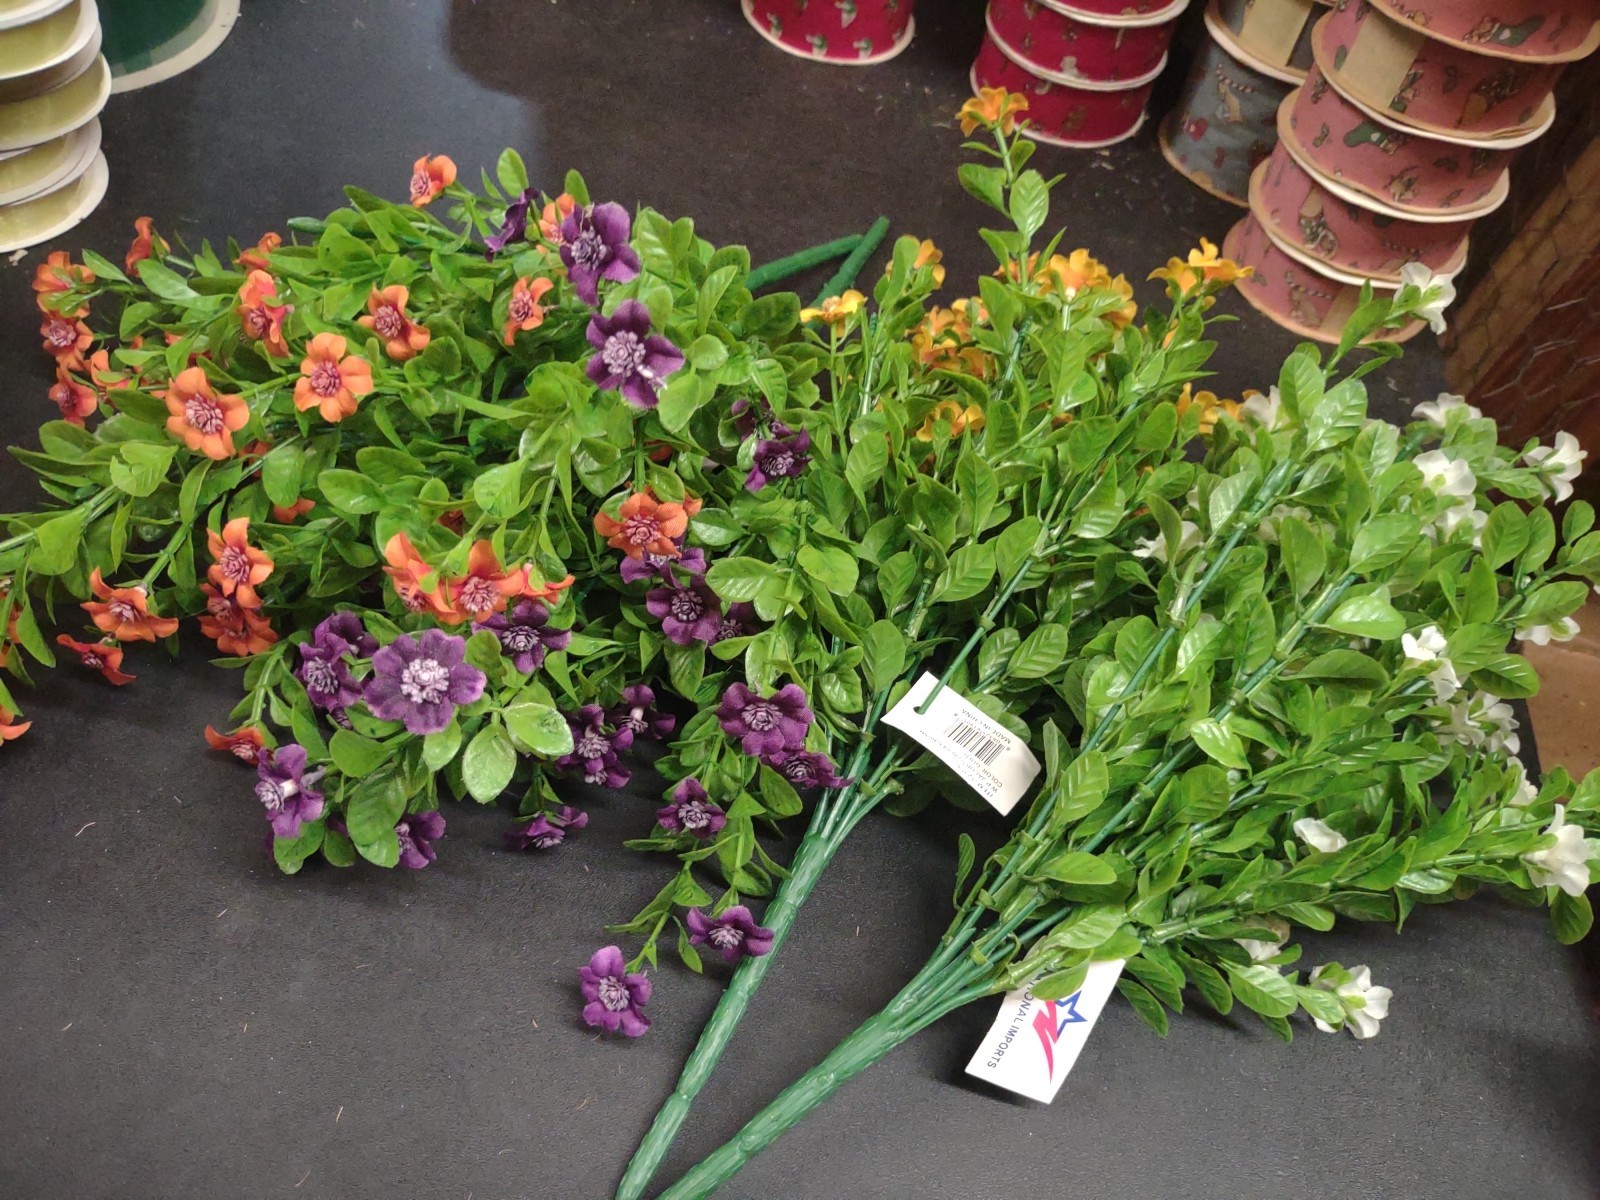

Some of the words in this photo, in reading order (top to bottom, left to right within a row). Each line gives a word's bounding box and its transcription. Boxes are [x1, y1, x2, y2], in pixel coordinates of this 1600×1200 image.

[961, 708, 983, 726] CHINA
[983, 723, 991, 731] IN
[992, 729, 1012, 745] MADE
[981, 768, 1004, 788] COLOR
[987, 1024, 1020, 1069] IMPORTS
